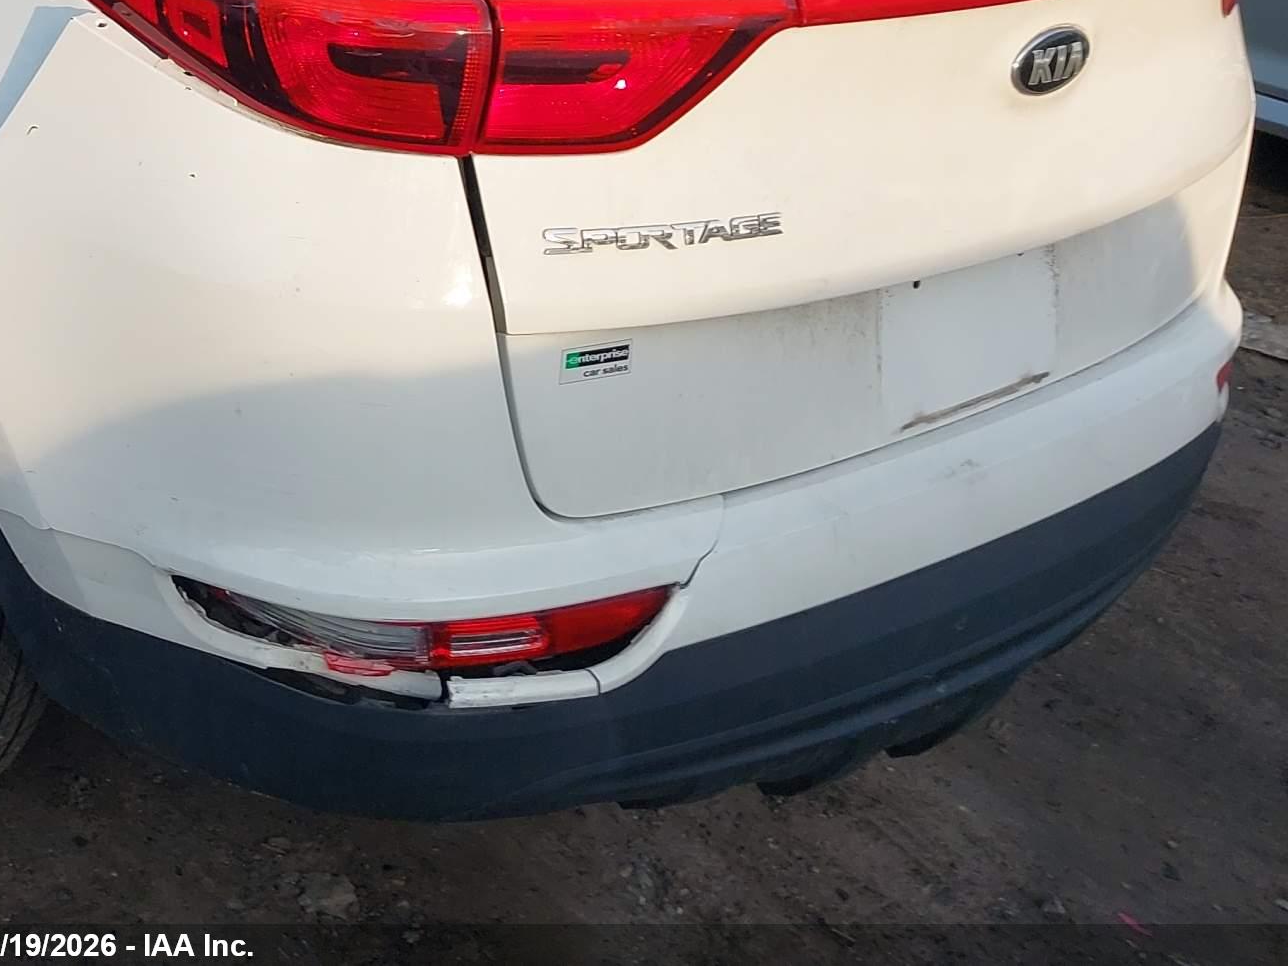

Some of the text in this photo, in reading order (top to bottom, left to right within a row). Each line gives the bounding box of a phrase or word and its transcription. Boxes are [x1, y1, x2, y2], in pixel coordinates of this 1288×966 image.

[1027, 41, 1083, 85] KIA
[542, 212, 784, 256] SPORTAGE
[567, 348, 629, 365] enterprise
[583, 364, 629, 377] car sales
